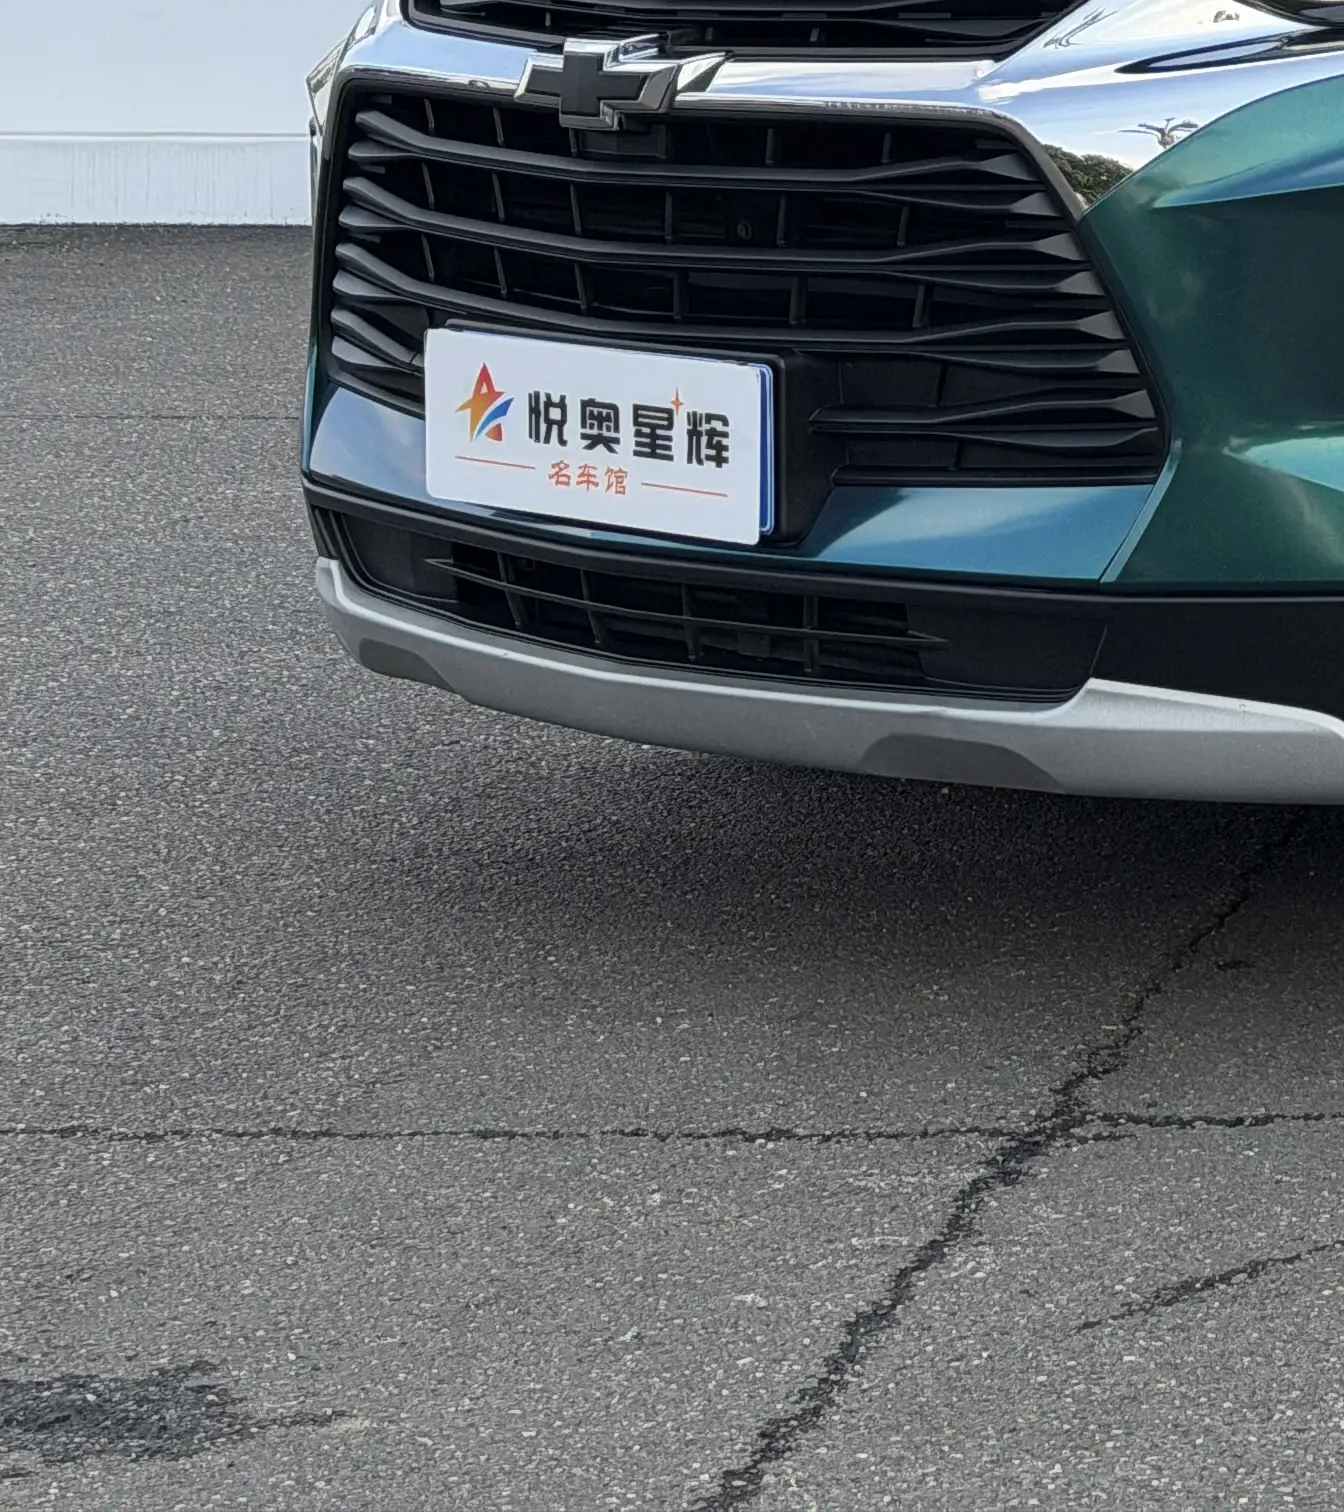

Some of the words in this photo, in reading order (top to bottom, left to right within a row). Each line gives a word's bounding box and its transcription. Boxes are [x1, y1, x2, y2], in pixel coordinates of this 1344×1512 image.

[527, 390, 731, 469] 悦奥星辉
[548, 459, 629, 496] 名车馆
